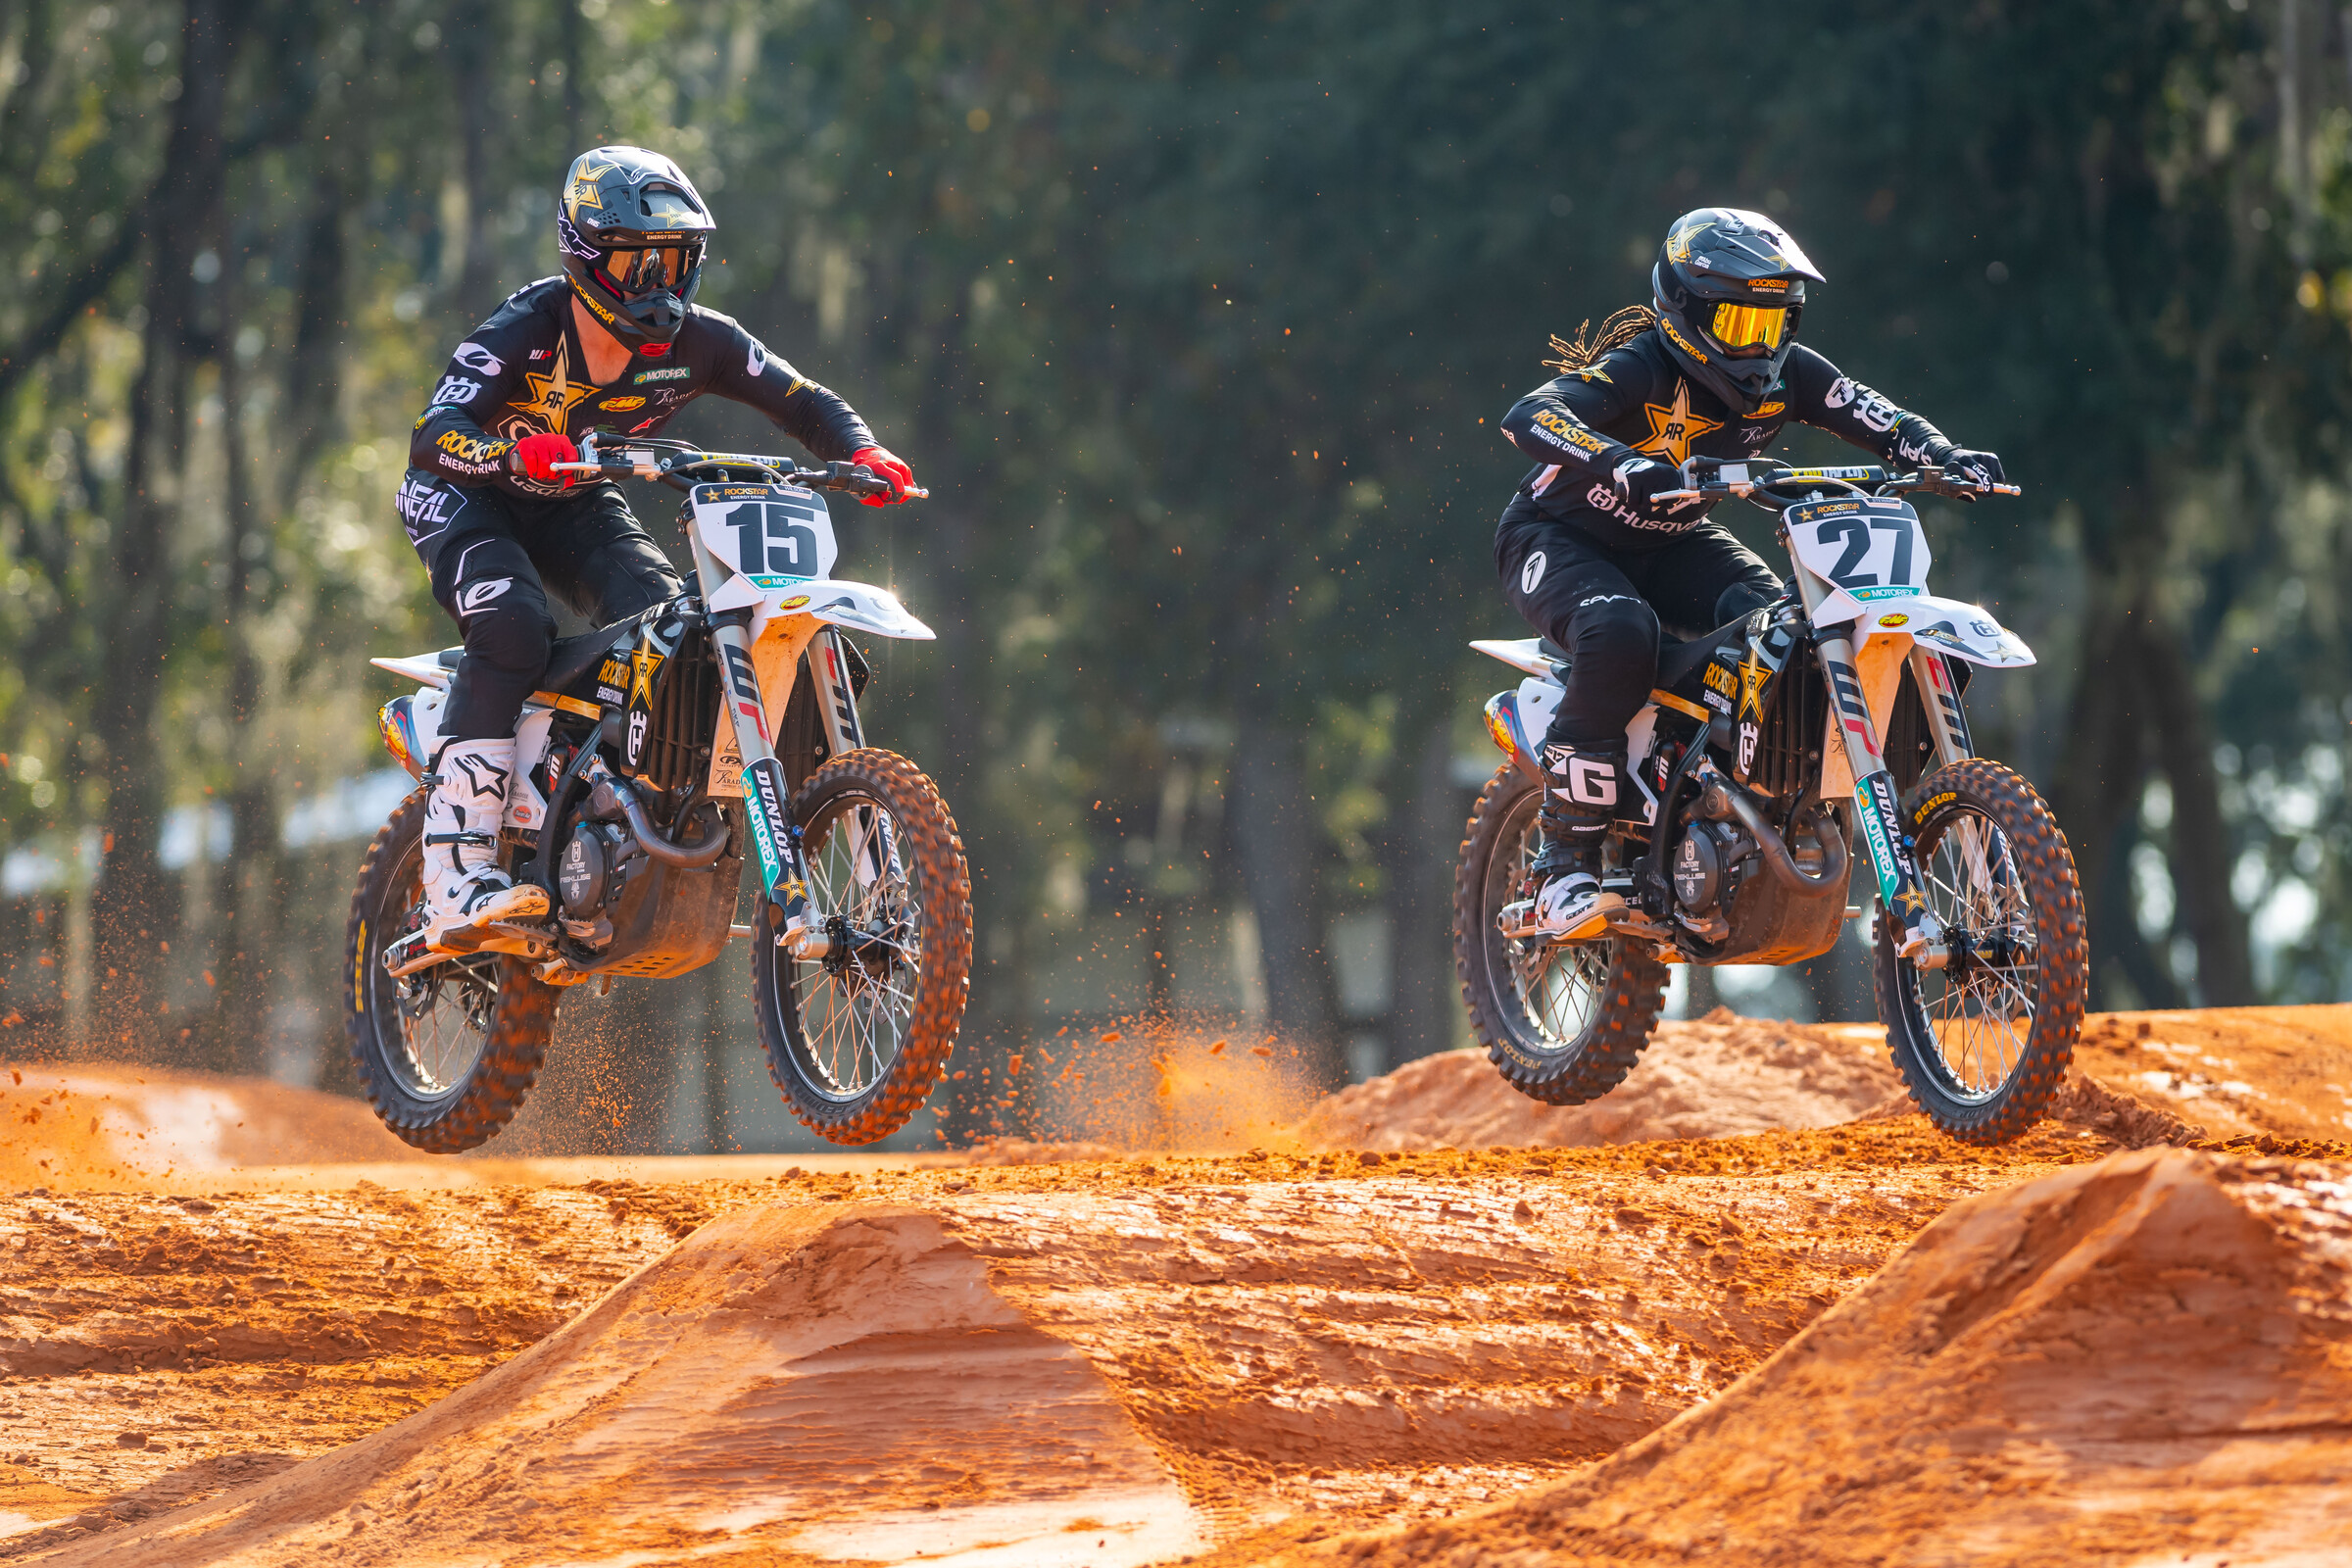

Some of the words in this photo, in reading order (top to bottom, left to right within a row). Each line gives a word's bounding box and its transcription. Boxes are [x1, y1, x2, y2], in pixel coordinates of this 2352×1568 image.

[1747, 278, 1789, 289] ROCKSTAR
[1661, 318, 1709, 366] ROCKSTAR
[646, 368, 688, 381] MOTOREX
[1529, 423, 1565, 448] ENERGY
[1561, 440, 1592, 463] DRINK
[1531, 409, 1608, 455] ROCKSTAR
[724, 487, 768, 496] ROCKSTAR
[1612, 504, 1709, 533] Husqva
[1816, 503, 1860, 514] ROCKSTAR
[725, 503, 818, 577] 15
[1816, 517, 1914, 589] 27
[772, 577, 807, 586] MOTOR
[1871, 589, 1914, 598] MOTOREX
[1878, 612, 1910, 628] FMF
[598, 659, 631, 690] ROCKSTAR
[1702, 662, 1739, 701] ROCKSTAR
[596, 685, 615, 703] ENERGY
[1703, 689, 1722, 709] ENERGY
[713, 769, 742, 784] PARAD
[1569, 757, 1617, 806] G
[755, 769, 795, 864] DUNLOP
[1914, 792, 1958, 825] DUNLOP
[747, 796, 778, 871] MOTOREX
[1872, 780, 1913, 876] DUNLOP
[1862, 807, 1896, 882] MOTOREX
[565, 861, 586, 871] FACTORY
[1680, 860, 1700, 869] FACTORY
[1496, 1037, 1544, 1070] DUNLOP
